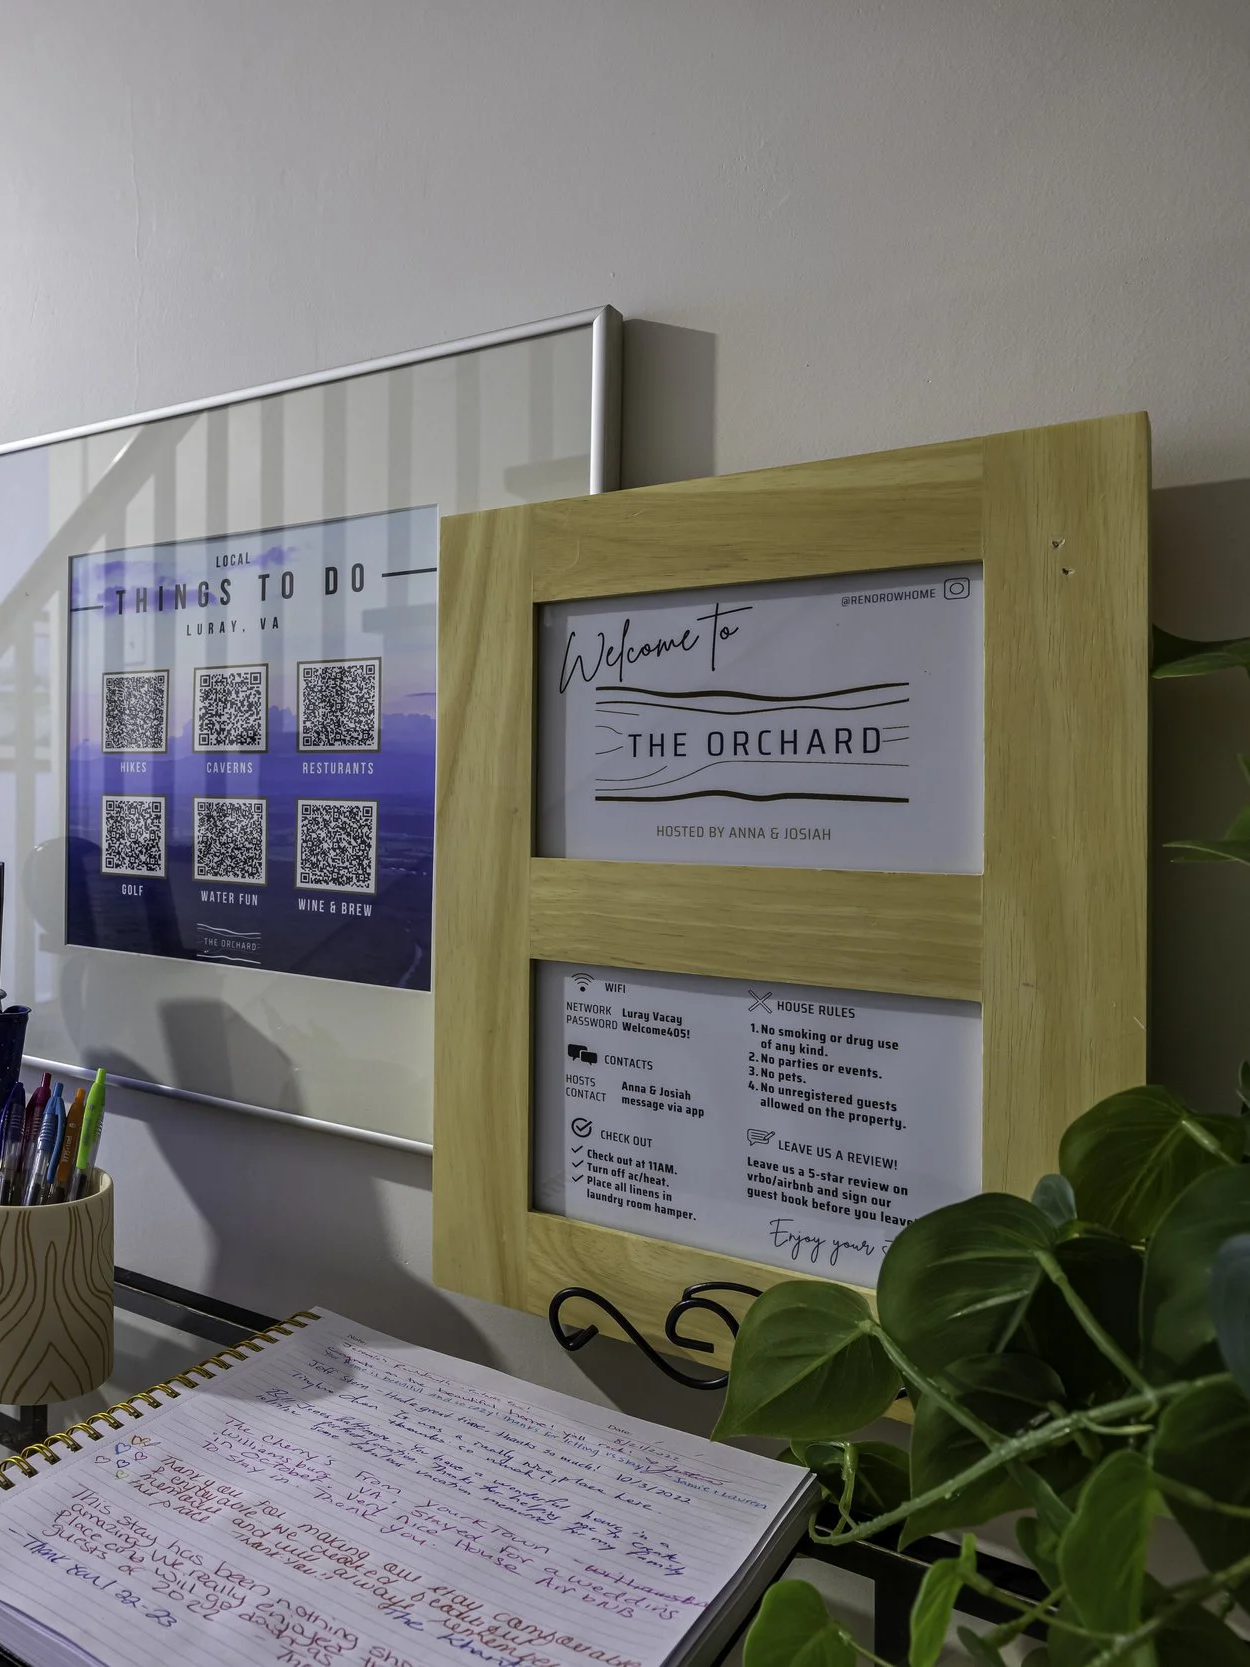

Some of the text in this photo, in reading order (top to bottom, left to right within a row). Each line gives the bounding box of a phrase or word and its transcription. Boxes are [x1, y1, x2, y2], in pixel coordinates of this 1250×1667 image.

[216, 555, 251, 568] LOCAL
[116, 563, 364, 615] THINGS TO DO
[841, 589, 936, 607] @RENOROWHOME
[187, 617, 279, 636] LURAY, VA
[559, 603, 753, 694] Welcome to
[628, 727, 881, 758] THE ORCHARD
[120, 762, 147, 773] HIKES
[206, 762, 253, 774] CAVERNS
[302, 762, 374, 775] RESTURANTS
[656, 825, 831, 840] HOSTED BY ANNA & JOSIAH
[122, 884, 143, 896] GOLF
[201, 891, 258, 906] WATER FUN
[298, 898, 372, 917] WINE & BREW
[204, 938, 257, 950] THE ORCHARD
[605, 983, 626, 993] WIFI
[566, 1002, 682, 1025] NETWORK Luray Vacay
[777, 1001, 855, 1018] HOUSE RULES
[566, 1015, 690, 1038] PASSWORD Welcome405!
[761, 1024, 775, 1035] No
[779, 1027, 826, 1044] smoking
[830, 1033, 842, 1043] or
[846, 1034, 873, 1050] drug
[878, 1039, 898, 1050] use
[761, 1040, 828, 1057] of any kind.
[605, 1055, 653, 1070] CONTACTS
[761, 1054, 774, 1064] No
[778, 1057, 818, 1071] parties
[822, 1062, 834, 1072] or
[838, 1065, 882, 1079] events.
[566, 1074, 691, 1100] HOSTS Anna & Josiah
[761, 1068, 774, 1079] No
[778, 1071, 806, 1085] pets.
[566, 1087, 704, 1118] CONTACT message via app
[761, 1083, 774, 1094] No
[778, 1086, 852, 1105] unregistered
[857, 1097, 897, 1112] guests
[760, 1098, 906, 1130] allowed on the property.
[601, 1130, 652, 1148] CHECK OUT
[587, 1149, 678, 1174] Check out at 11AM.
[778, 1140, 898, 1170] LEAVE US A REVIEW!
[587, 1163, 670, 1187] Turn off ac/heat.
[748, 1157, 908, 1195] Leave us a 5-star review on
[587, 1176, 672, 1201] Place all linens in
[747, 1172, 891, 1208] vrbo/airbnb and sign our
[587, 1189, 696, 1220] laundry room hamper.
[747, 1187, 777, 1201] guest
[781, 1192, 808, 1207] book
[812, 1198, 850, 1215] before
[854, 1207, 876, 1221] you
[769, 1219, 826, 1263] Enjoy
[830, 1237, 875, 1266] your
[414, 1405, 454, 1418] great
[559, 1455, 601, 1472] much!
[615, 1472, 691, 1504] 10/3/2022
[312, 1485, 377, 1523] Thank
[345, 1491, 389, 1517] Very
[69, 1503, 348, 1654] amazing We really enjoyed
[70, 1482, 111, 1515] This
[165, 1538, 204, 1566] has
[213, 1559, 271, 1597] been
[273, 1597, 359, 1650] nothing
[150, 1579, 220, 1622] 2022
